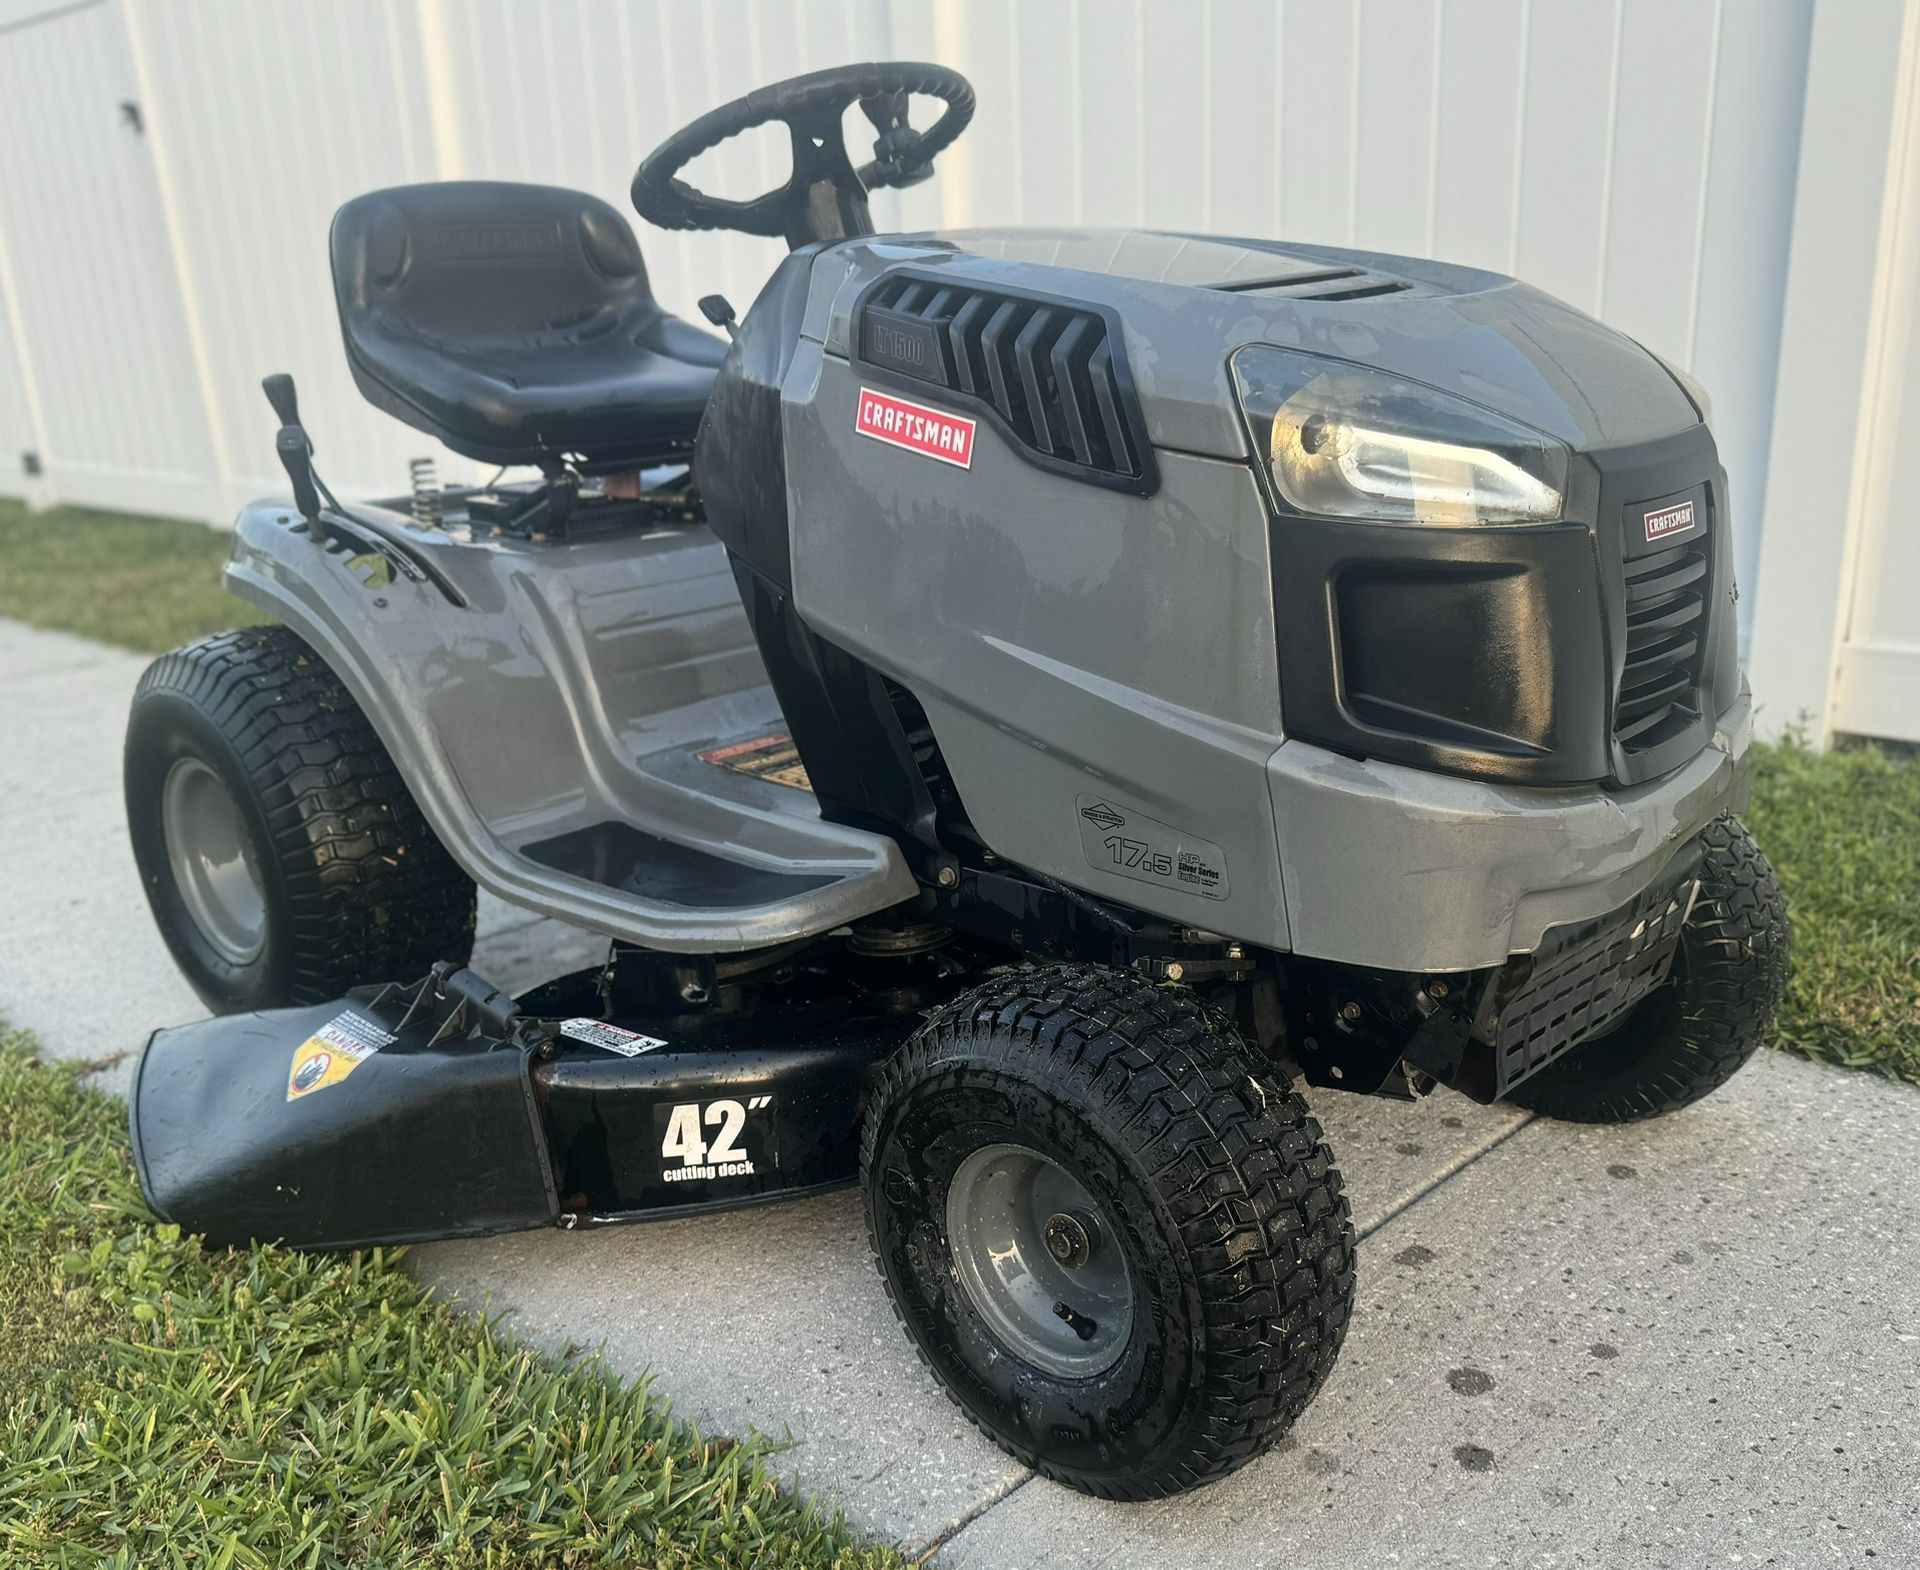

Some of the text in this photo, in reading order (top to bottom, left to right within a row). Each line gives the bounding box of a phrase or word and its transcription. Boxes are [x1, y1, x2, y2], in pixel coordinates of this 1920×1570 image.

[874, 325, 924, 366] LT 1500
[863, 401, 966, 454] CRAFTSMAN
[1649, 508, 1691, 533] CRAFTSMAN
[1104, 835, 1173, 877] 17.5
[1178, 852, 1201, 864] HP
[663, 1160, 755, 1183] cutting deck
